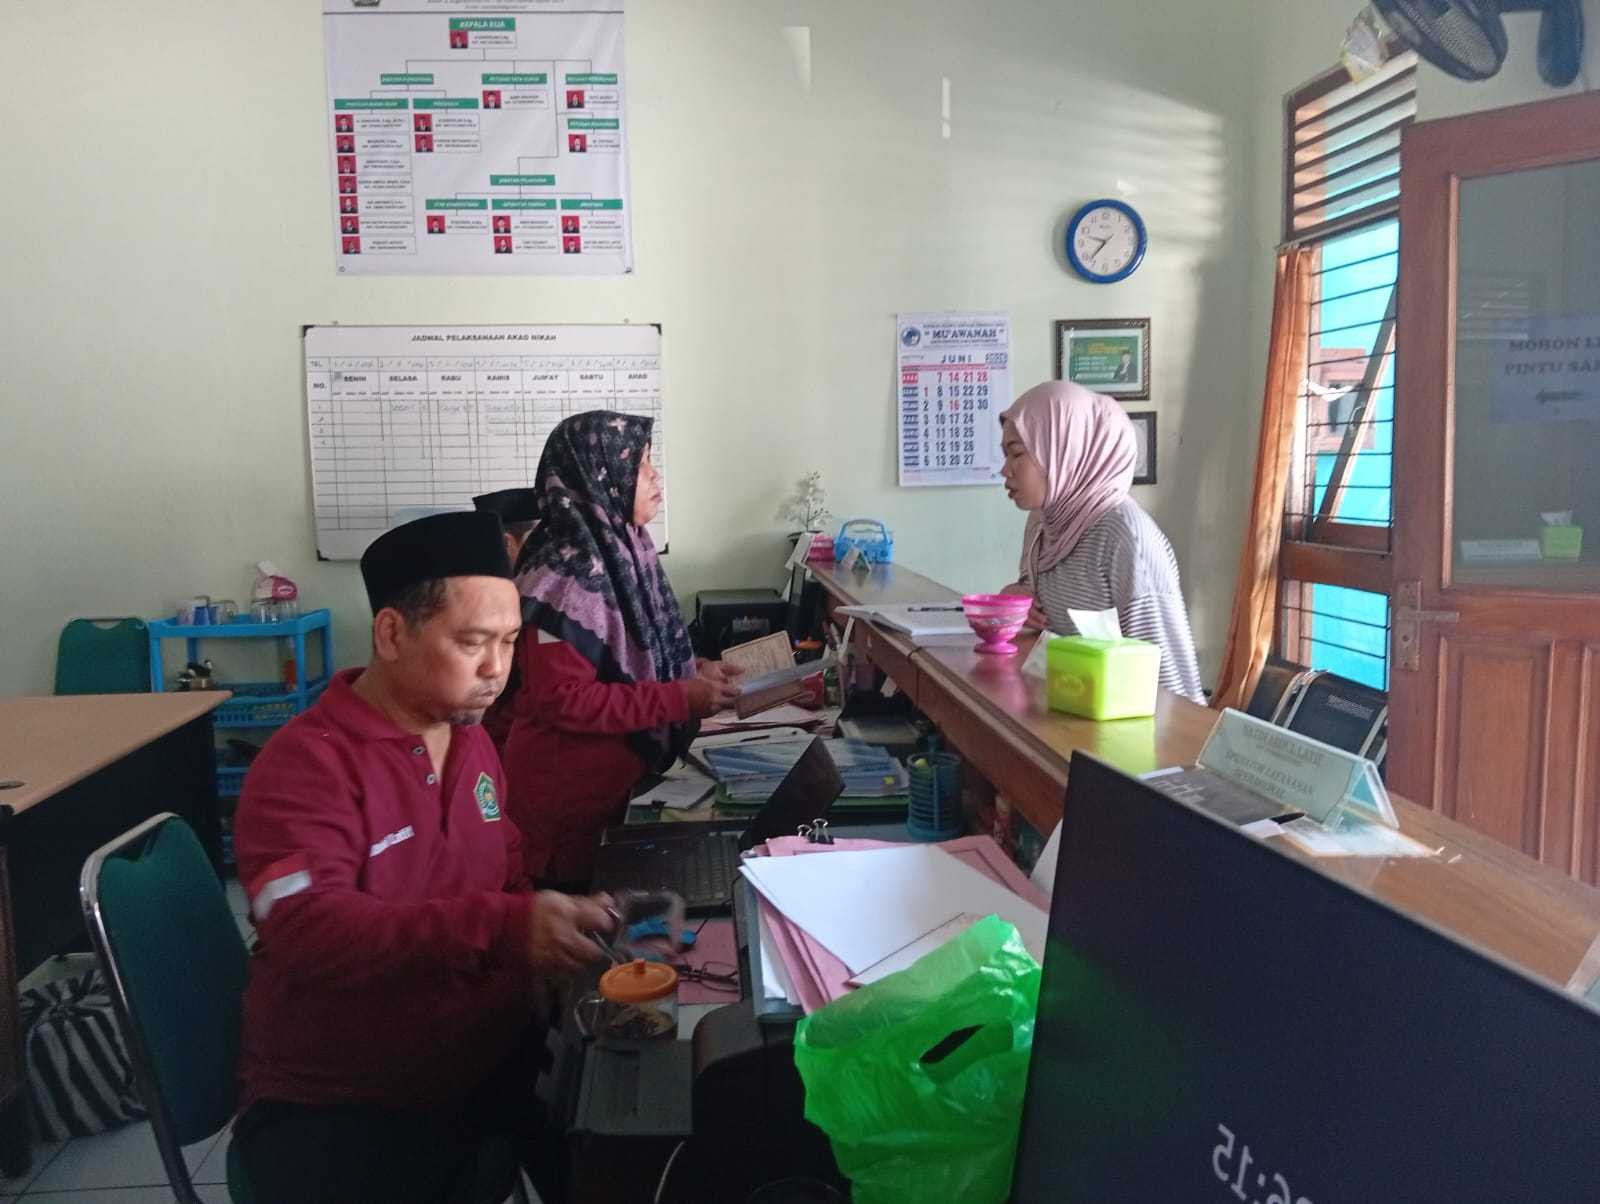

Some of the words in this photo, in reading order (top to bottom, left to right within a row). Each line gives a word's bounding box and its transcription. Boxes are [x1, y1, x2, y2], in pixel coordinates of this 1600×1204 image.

[1508, 337, 1580, 352] MOHON
[941, 354, 973, 363] JUNI
[1504, 361, 1564, 376] PINTU
[937, 372, 943, 382] 7
[949, 372, 959, 382] 14
[963, 372, 974, 382] 21
[976, 372, 988, 382] 28
[937, 386, 943, 397] 8
[949, 386, 959, 397] 15
[963, 386, 974, 397] 22
[976, 386, 988, 397] 29
[937, 400, 943, 411] 9
[949, 400, 959, 411] 16
[963, 400, 974, 411] 23
[976, 400, 988, 411] 30
[936, 414, 944, 425] 10
[949, 414, 959, 425] 17
[963, 414, 974, 425] 24
[936, 428, 944, 438] 11
[949, 428, 959, 438] 18
[963, 428, 974, 438] 25
[936, 442, 945, 452] 12
[949, 442, 960, 452] 19
[963, 442, 975, 452] 26
[936, 455, 945, 466] 13
[949, 455, 960, 466] 20
[963, 455, 975, 466] 27
